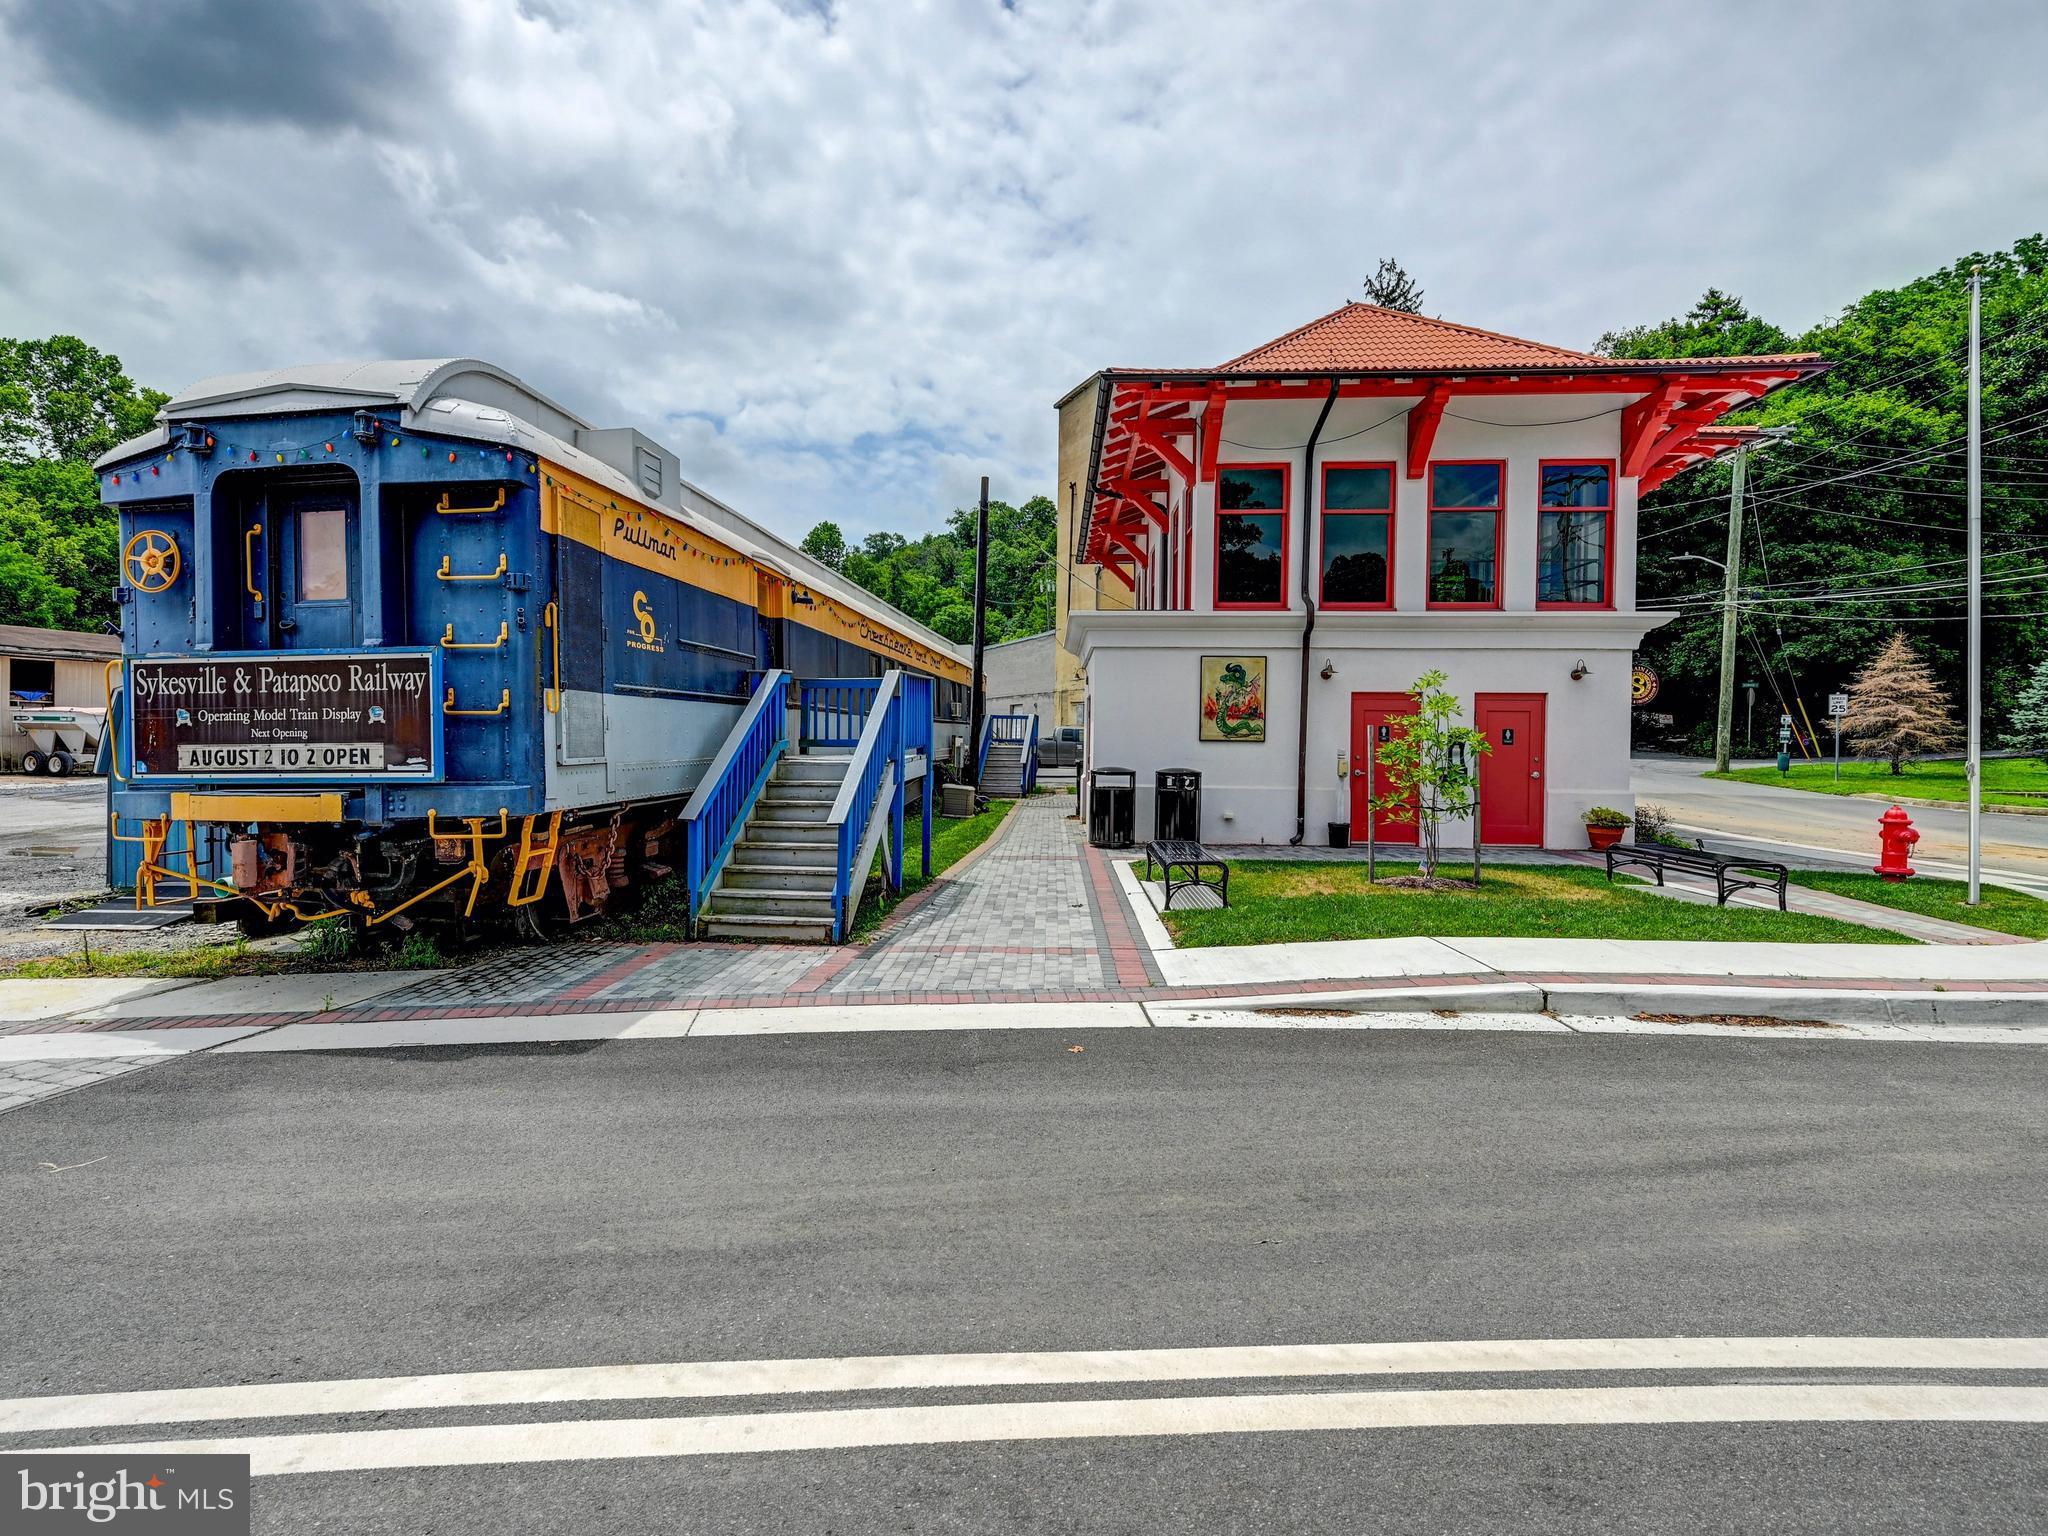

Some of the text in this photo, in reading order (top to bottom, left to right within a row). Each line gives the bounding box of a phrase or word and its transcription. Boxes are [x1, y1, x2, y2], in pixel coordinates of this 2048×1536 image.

[613, 517, 677, 561] Pullman
[626, 640, 664, 653] PROGRESS
[136, 663, 426, 703] Sykesville & Patapsco Railway
[198, 707, 362, 725] Operating Model Train Display
[1831, 705, 1846, 713] 25
[251, 727, 308, 740] Next Opening
[189, 748, 370, 767] AUGUST 2 10 2 OPEN
